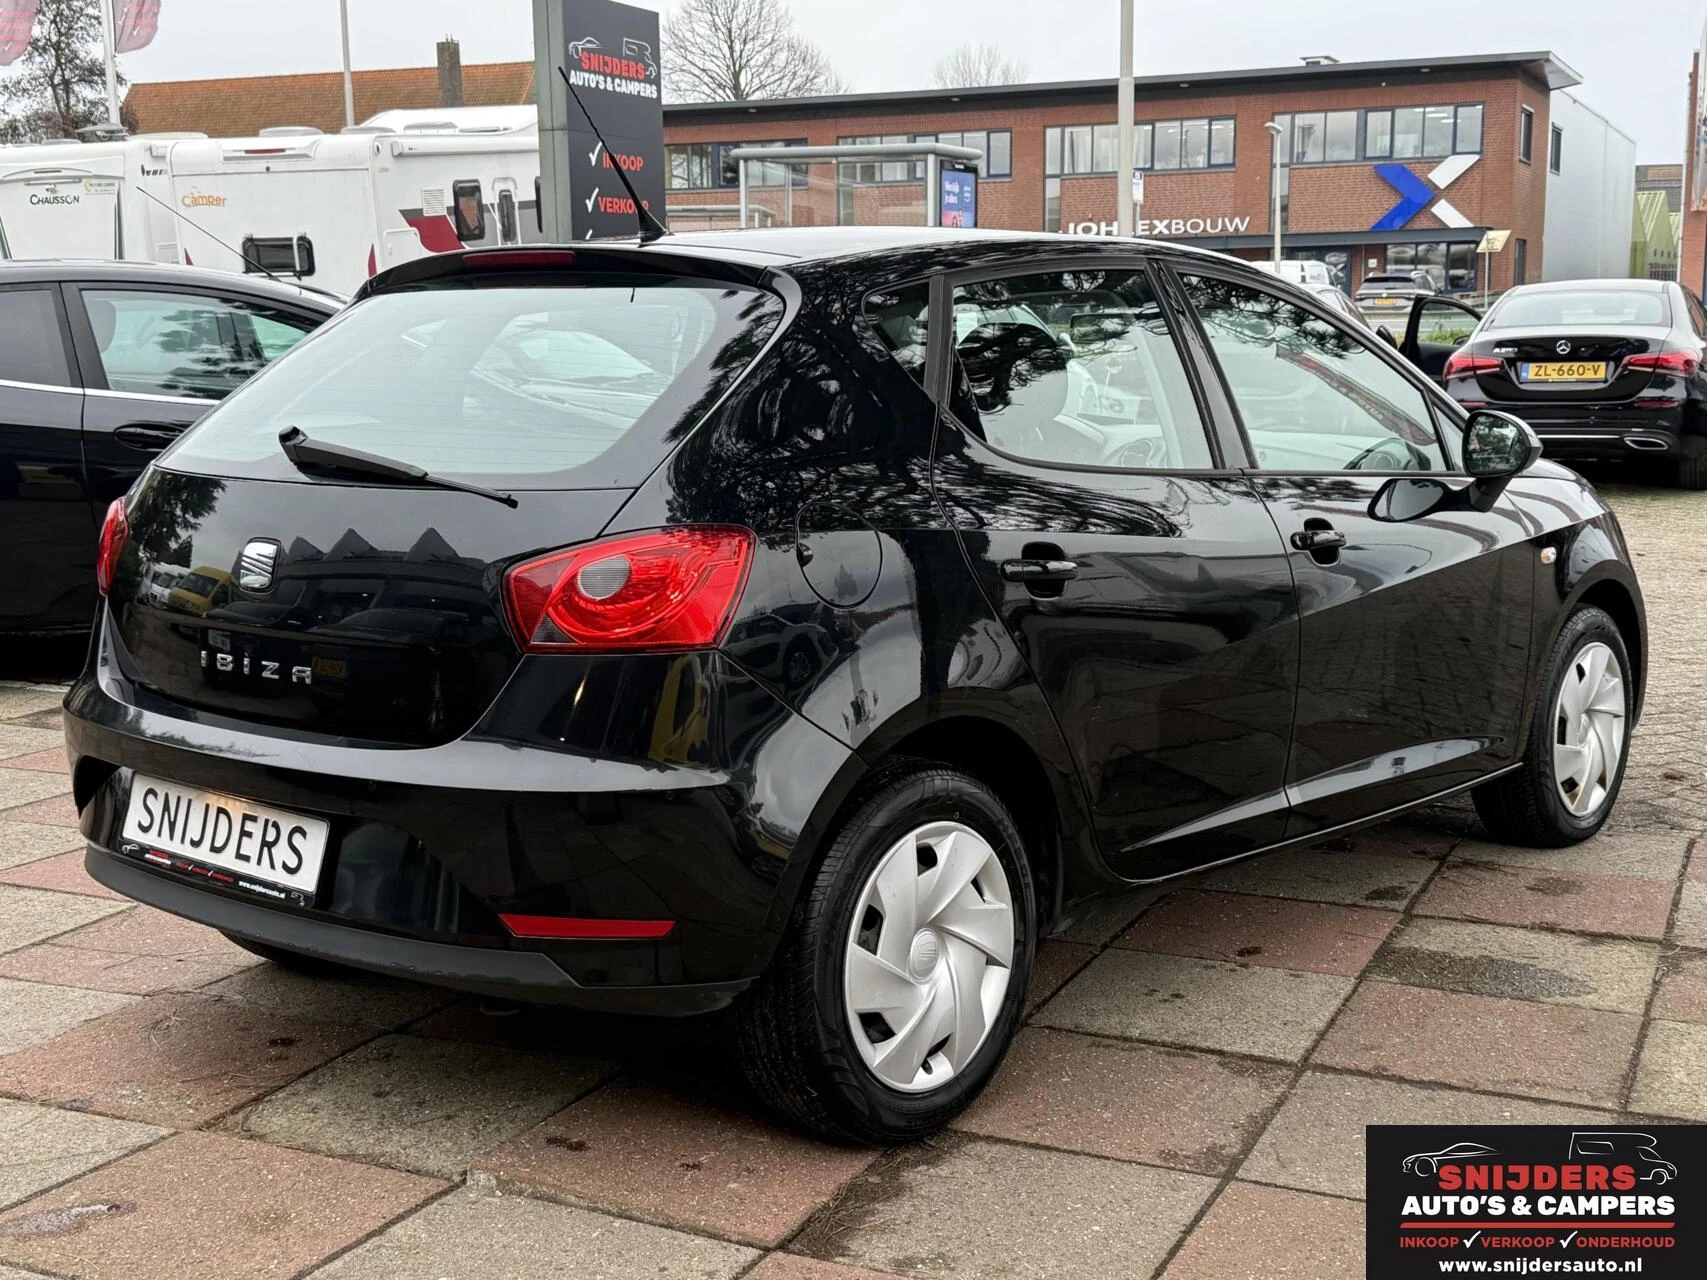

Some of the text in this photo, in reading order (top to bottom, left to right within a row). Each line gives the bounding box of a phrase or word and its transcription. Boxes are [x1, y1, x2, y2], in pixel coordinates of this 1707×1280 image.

[581, 51, 645, 80] SNIJDERS
[569, 69, 658, 99] AUTO'S & CAMPERS
[29, 194, 80, 206] CHAUSSON
[181, 194, 226, 208] Camper
[1534, 364, 1601, 377] ZL-660-V
[138, 788, 308, 875] SNIJDERS
